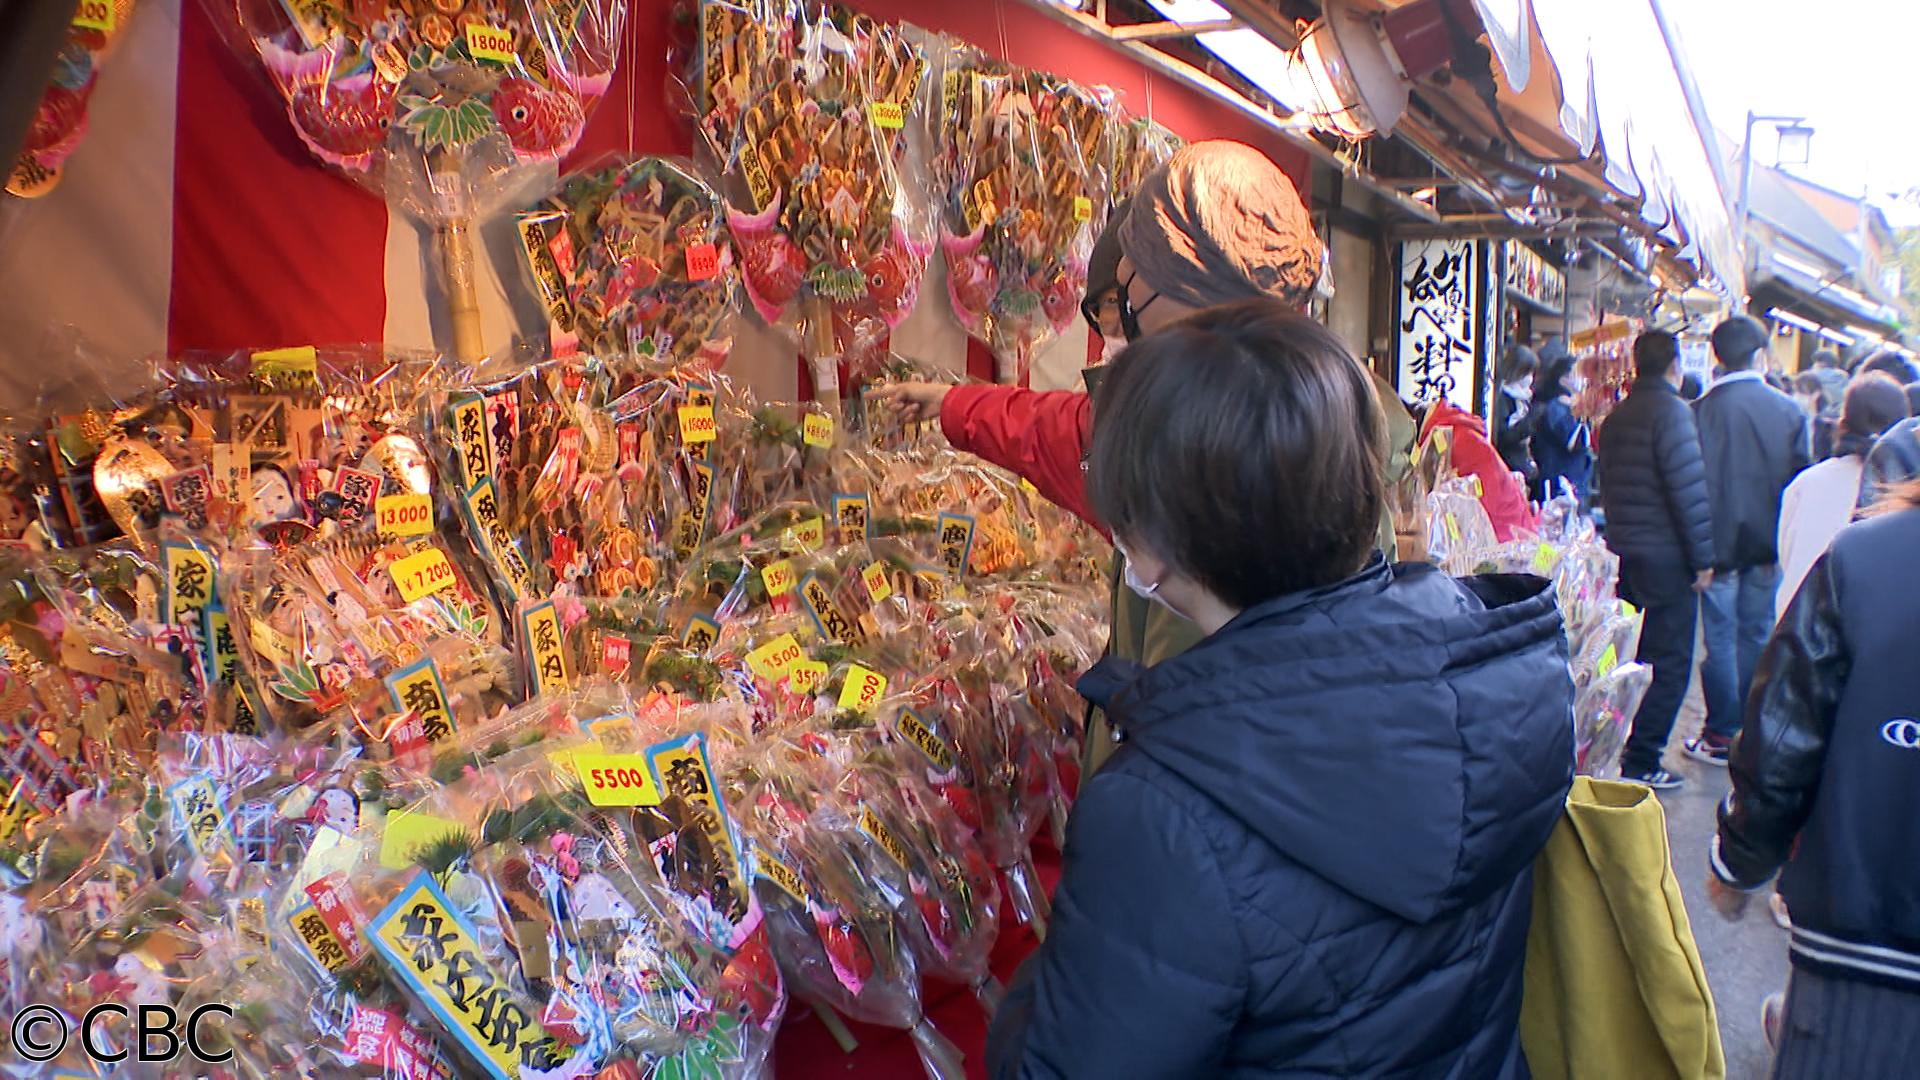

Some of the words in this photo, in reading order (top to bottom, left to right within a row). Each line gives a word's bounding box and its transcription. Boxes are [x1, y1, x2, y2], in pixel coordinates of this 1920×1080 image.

[472, 33, 515, 54] 18000
[458, 406, 486, 488] 家内
[533, 619, 563, 686] 家内
[403, 679, 451, 742] 商売
[591, 768, 643, 789] 5500
[300, 914, 347, 971] 商売
[393, 903, 566, 1074] 家内安全
